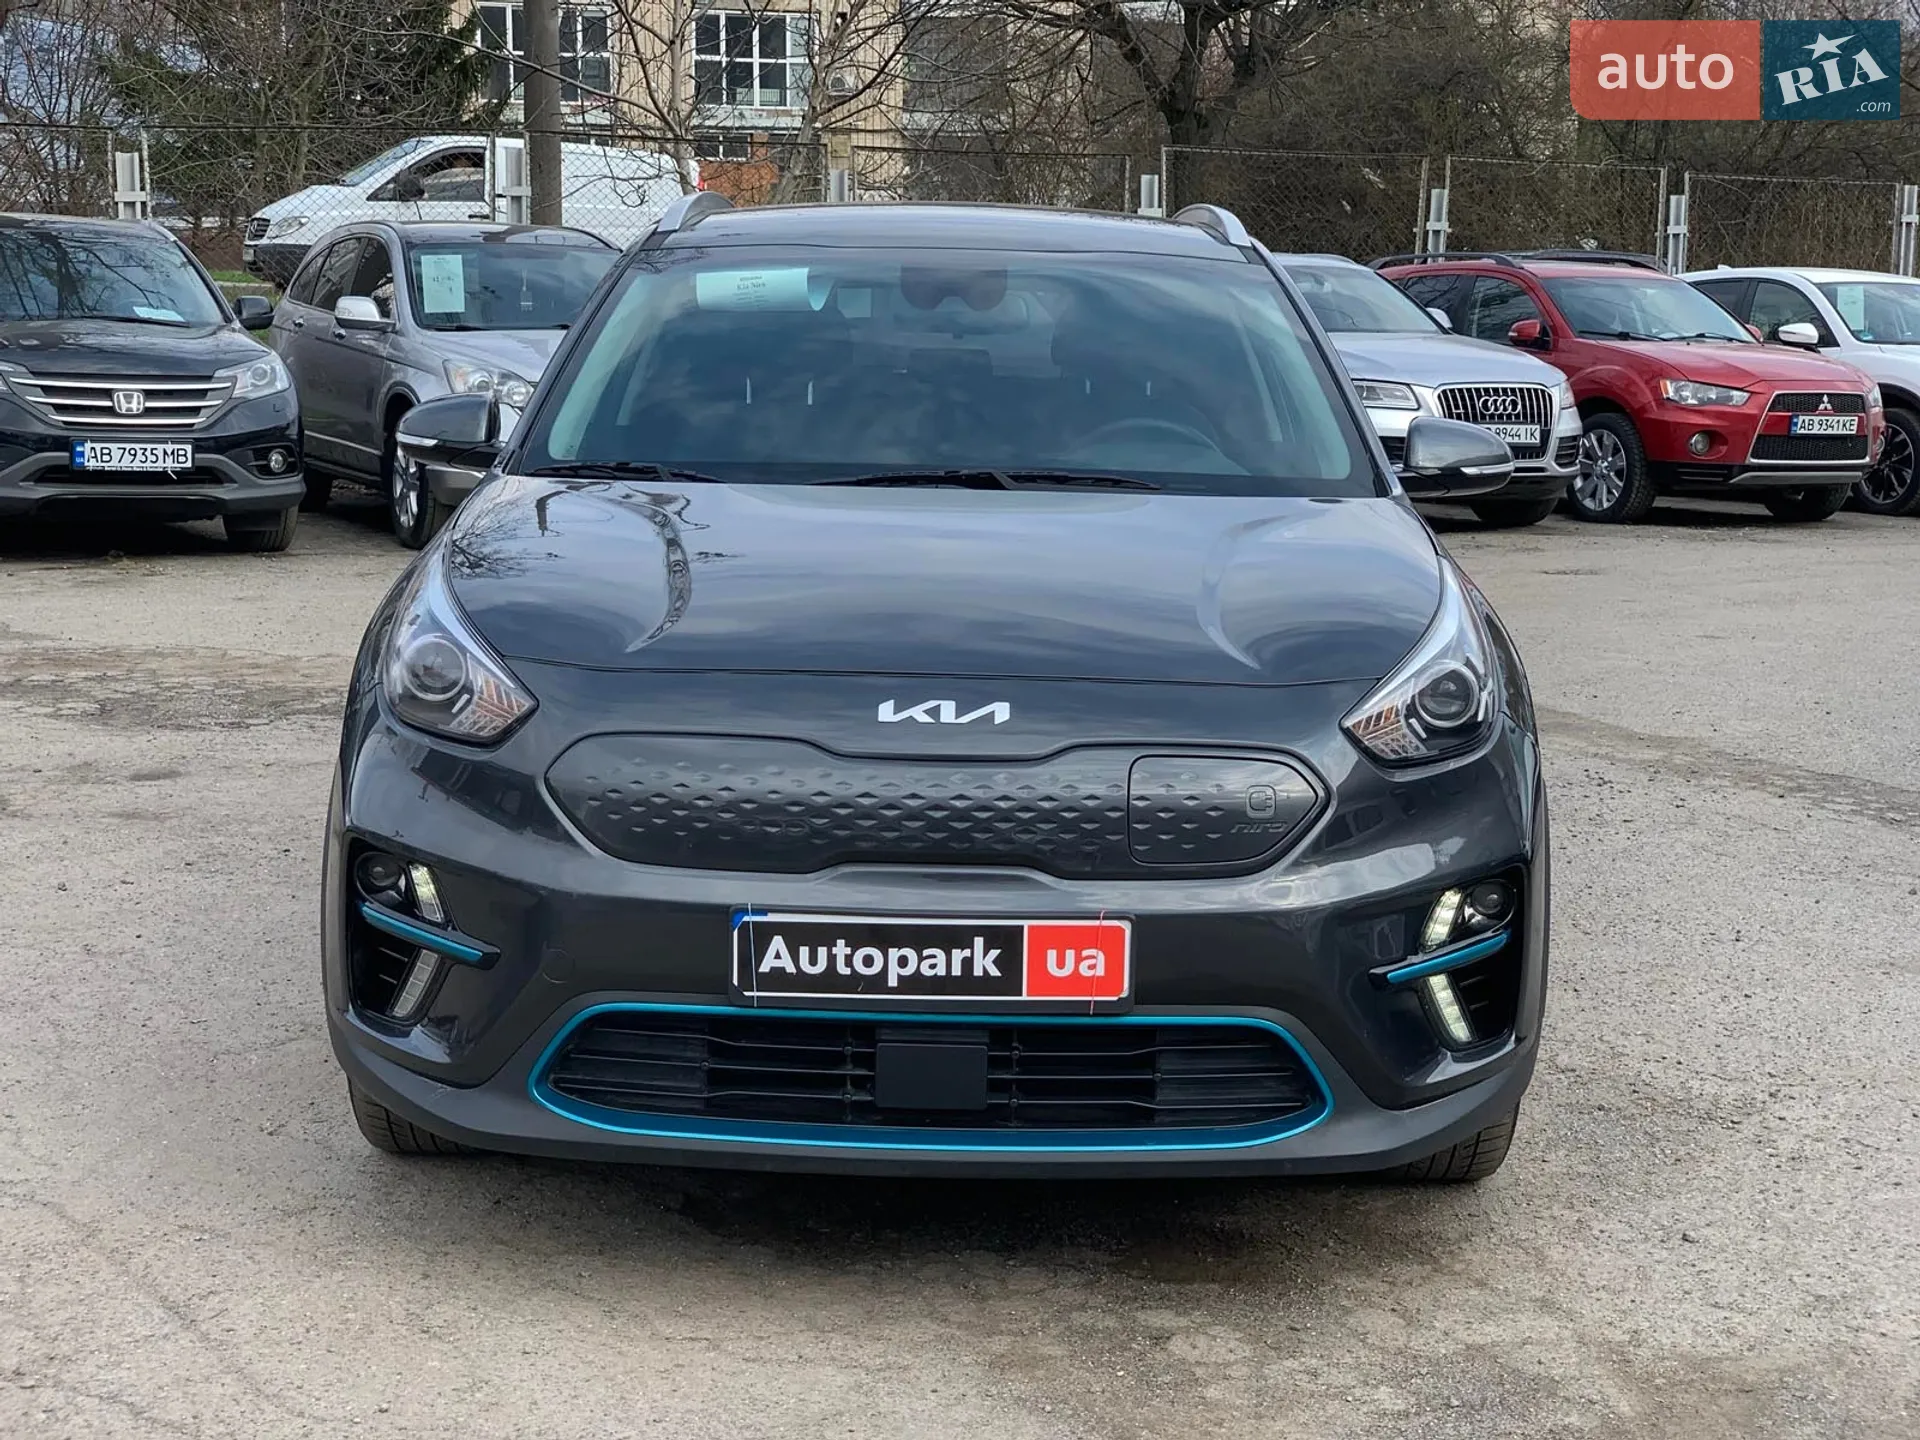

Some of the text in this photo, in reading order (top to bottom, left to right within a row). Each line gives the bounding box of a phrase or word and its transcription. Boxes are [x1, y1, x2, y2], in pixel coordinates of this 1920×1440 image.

[1798, 418, 1856, 432] AB 9341 KE
[1525, 427, 1539, 441] IK
[86, 446, 189, 464] AB 7935 MB
[757, 934, 1106, 987] Autopark ua
